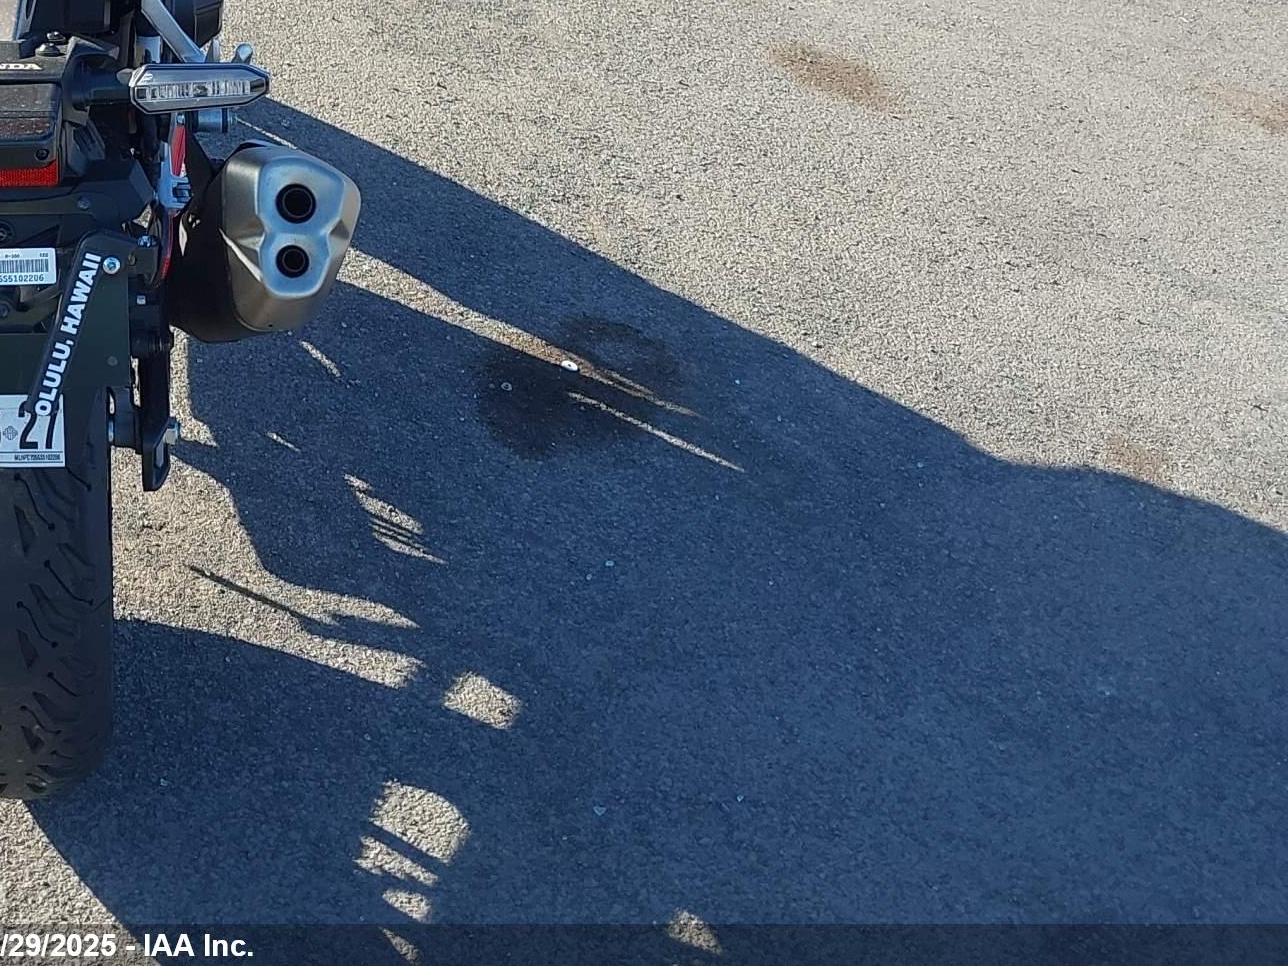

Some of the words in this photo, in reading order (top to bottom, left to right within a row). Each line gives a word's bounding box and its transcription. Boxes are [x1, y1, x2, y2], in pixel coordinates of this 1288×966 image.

[34, 339, 75, 417] OLULU,
[60, 252, 103, 335] HAWAII
[17, 400, 60, 450] 27
